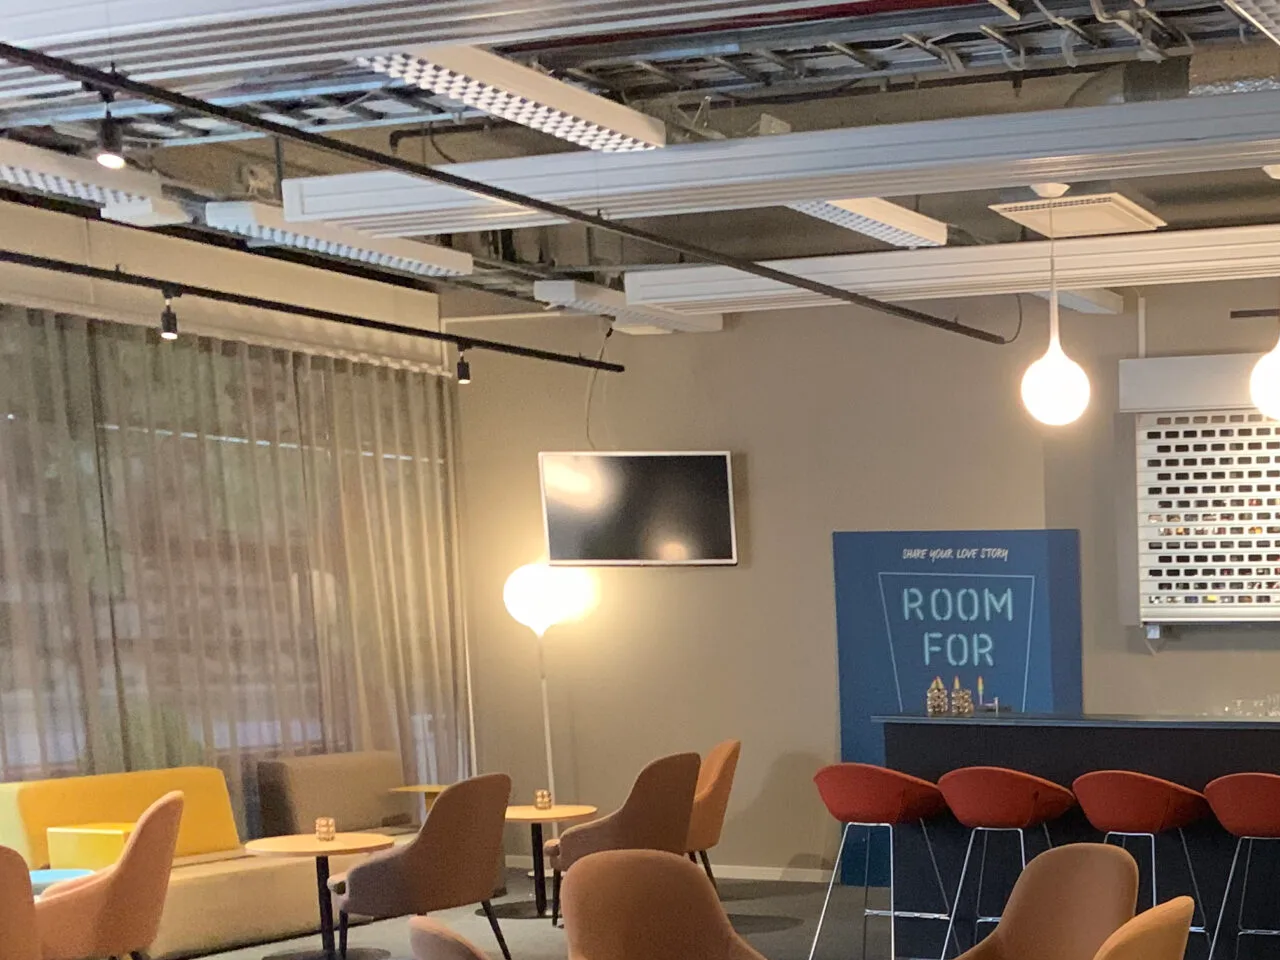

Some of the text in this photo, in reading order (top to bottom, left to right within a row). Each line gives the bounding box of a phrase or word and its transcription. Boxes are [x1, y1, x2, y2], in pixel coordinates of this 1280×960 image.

[903, 548, 928, 559] SHARE
[956, 548, 979, 559] LOVE
[980, 548, 1008, 562] STORY
[903, 587, 1013, 621] ROOM
[923, 632, 994, 666] FOR
